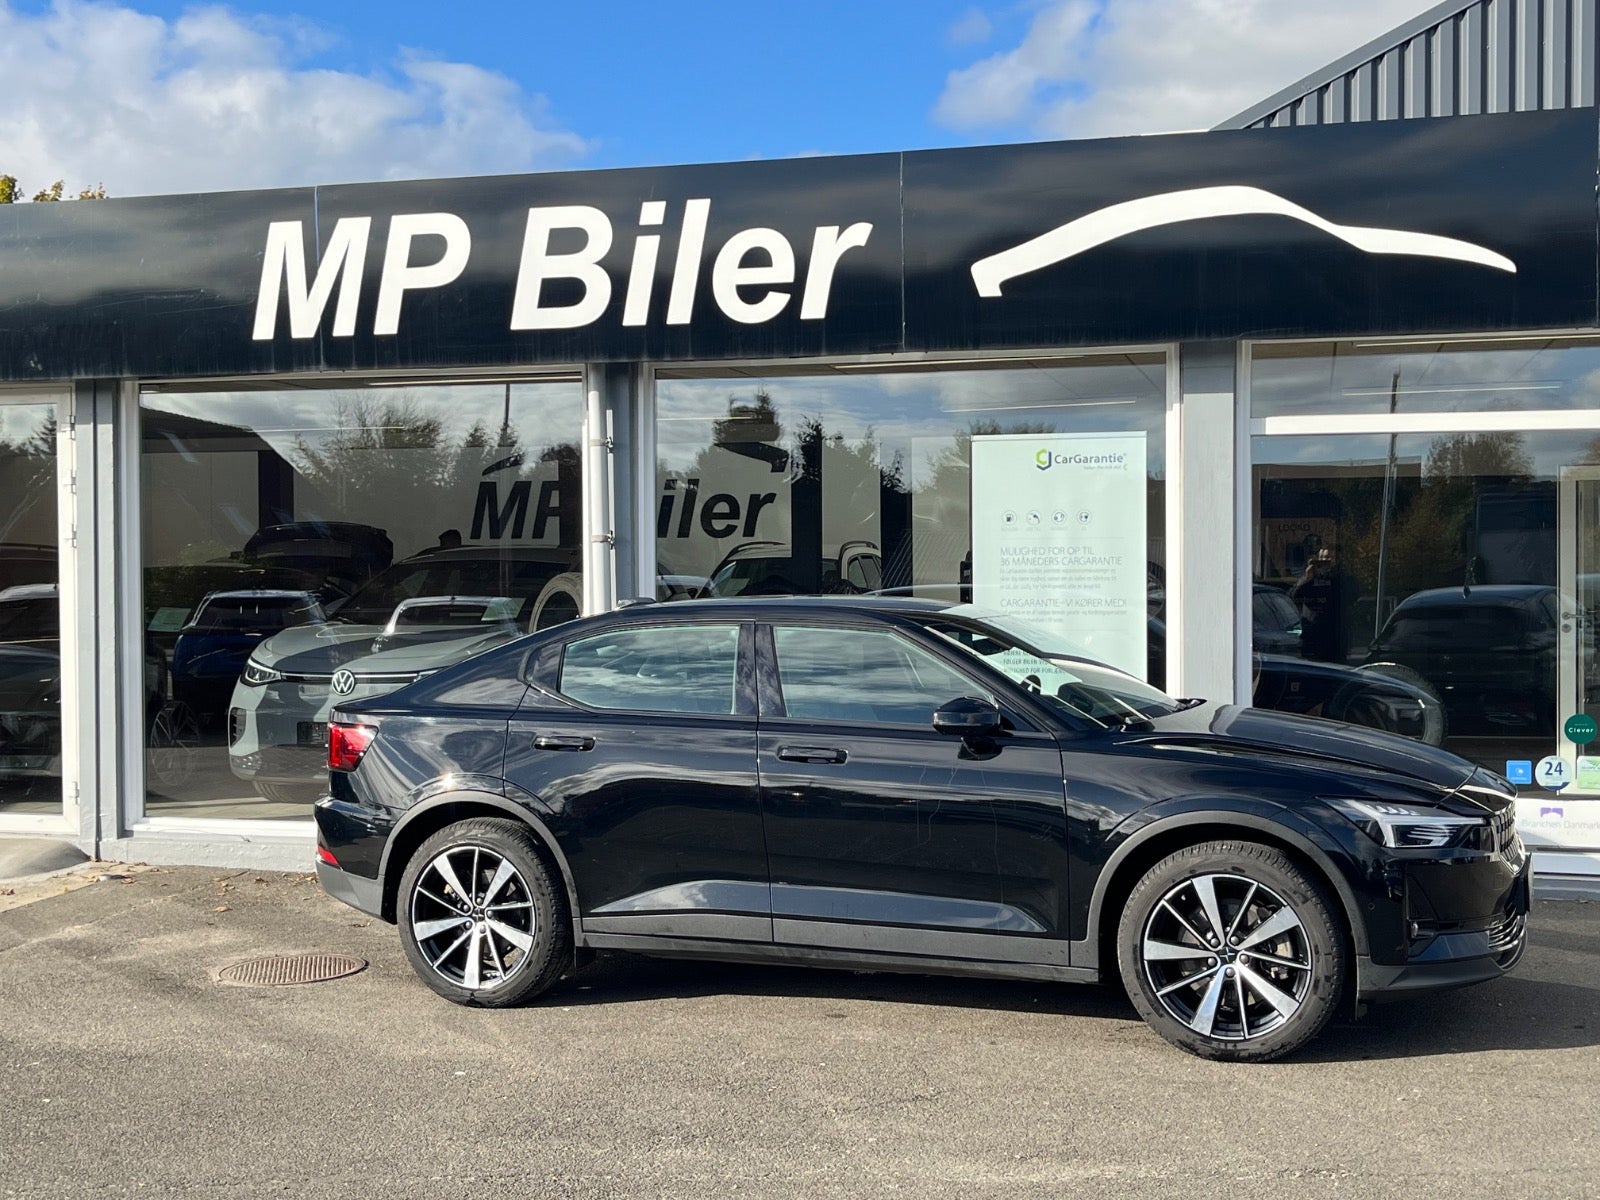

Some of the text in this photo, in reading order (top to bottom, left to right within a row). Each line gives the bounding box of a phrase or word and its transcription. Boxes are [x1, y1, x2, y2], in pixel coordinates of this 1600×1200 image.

[252, 197, 874, 340] MP Biler
[1054, 453, 1124, 464] CarGarantie
[1544, 761, 1564, 776] 24
